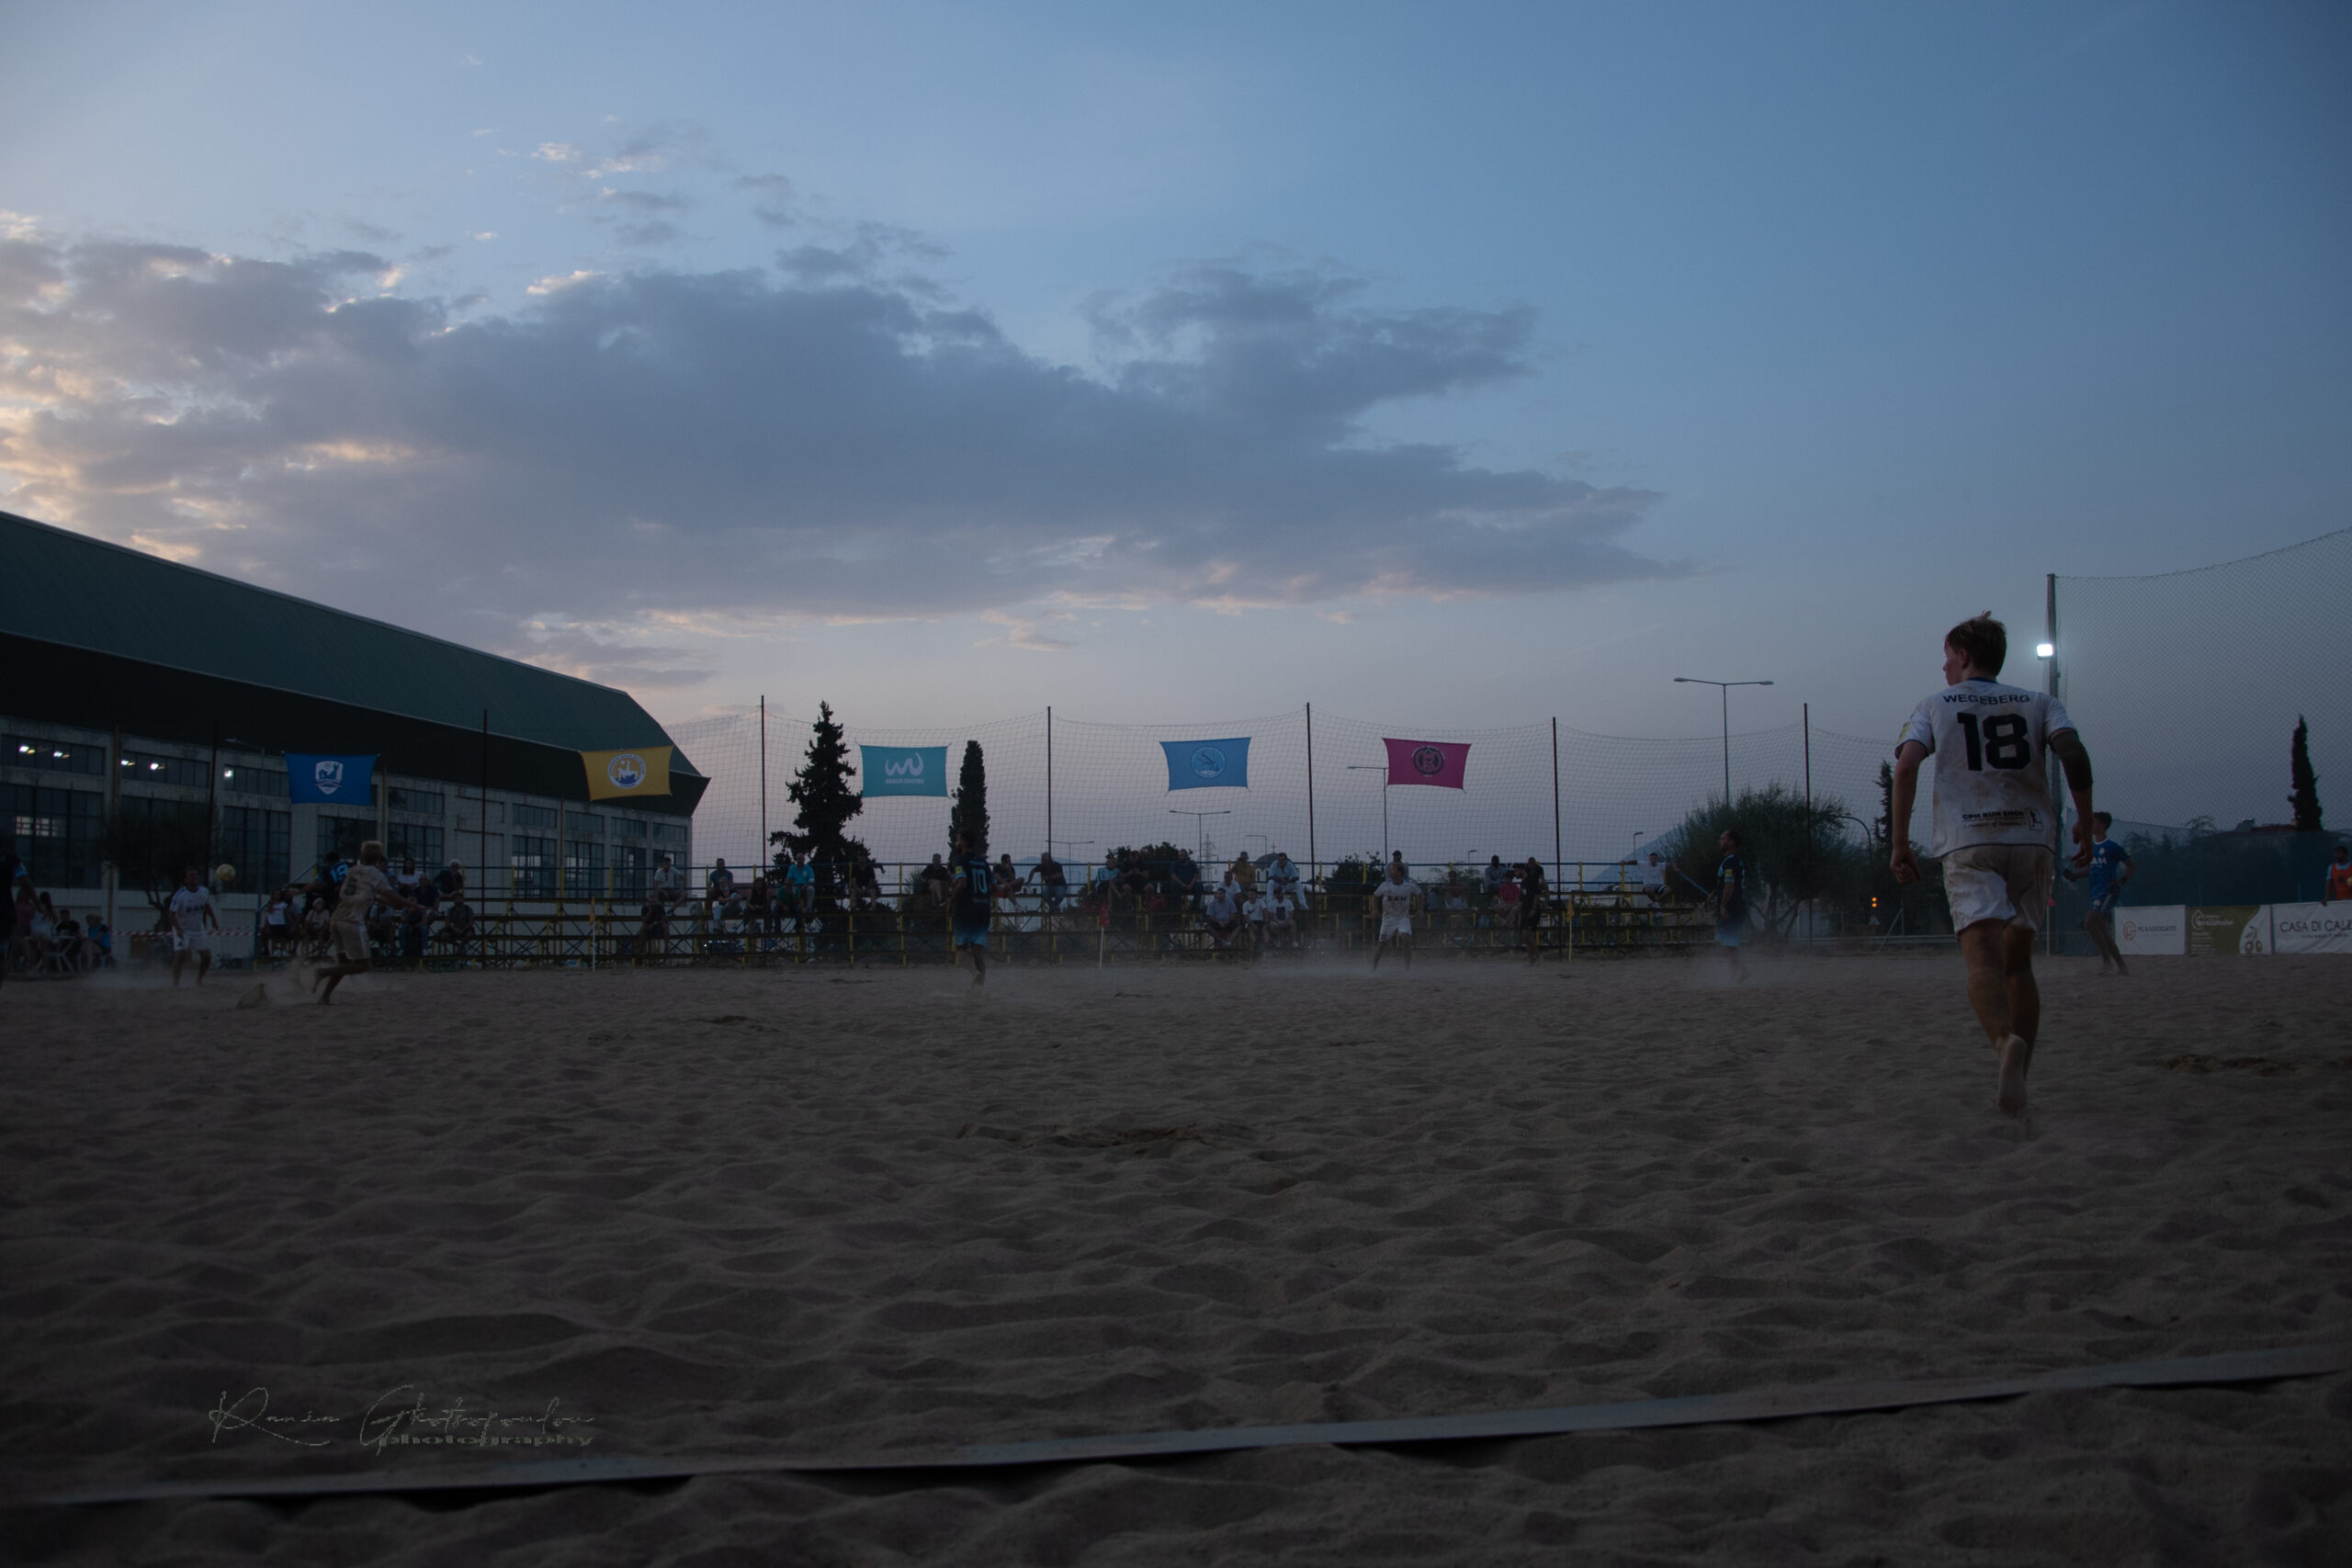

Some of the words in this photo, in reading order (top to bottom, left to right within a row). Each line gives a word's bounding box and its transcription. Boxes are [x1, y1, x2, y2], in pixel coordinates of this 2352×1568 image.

[1943, 694, 2030, 705] WEGEBERG
[1957, 712, 2030, 772] 18
[971, 867, 989, 895] 10
[2279, 921, 2308, 933] CASA
[2311, 920, 2322, 931] DI
